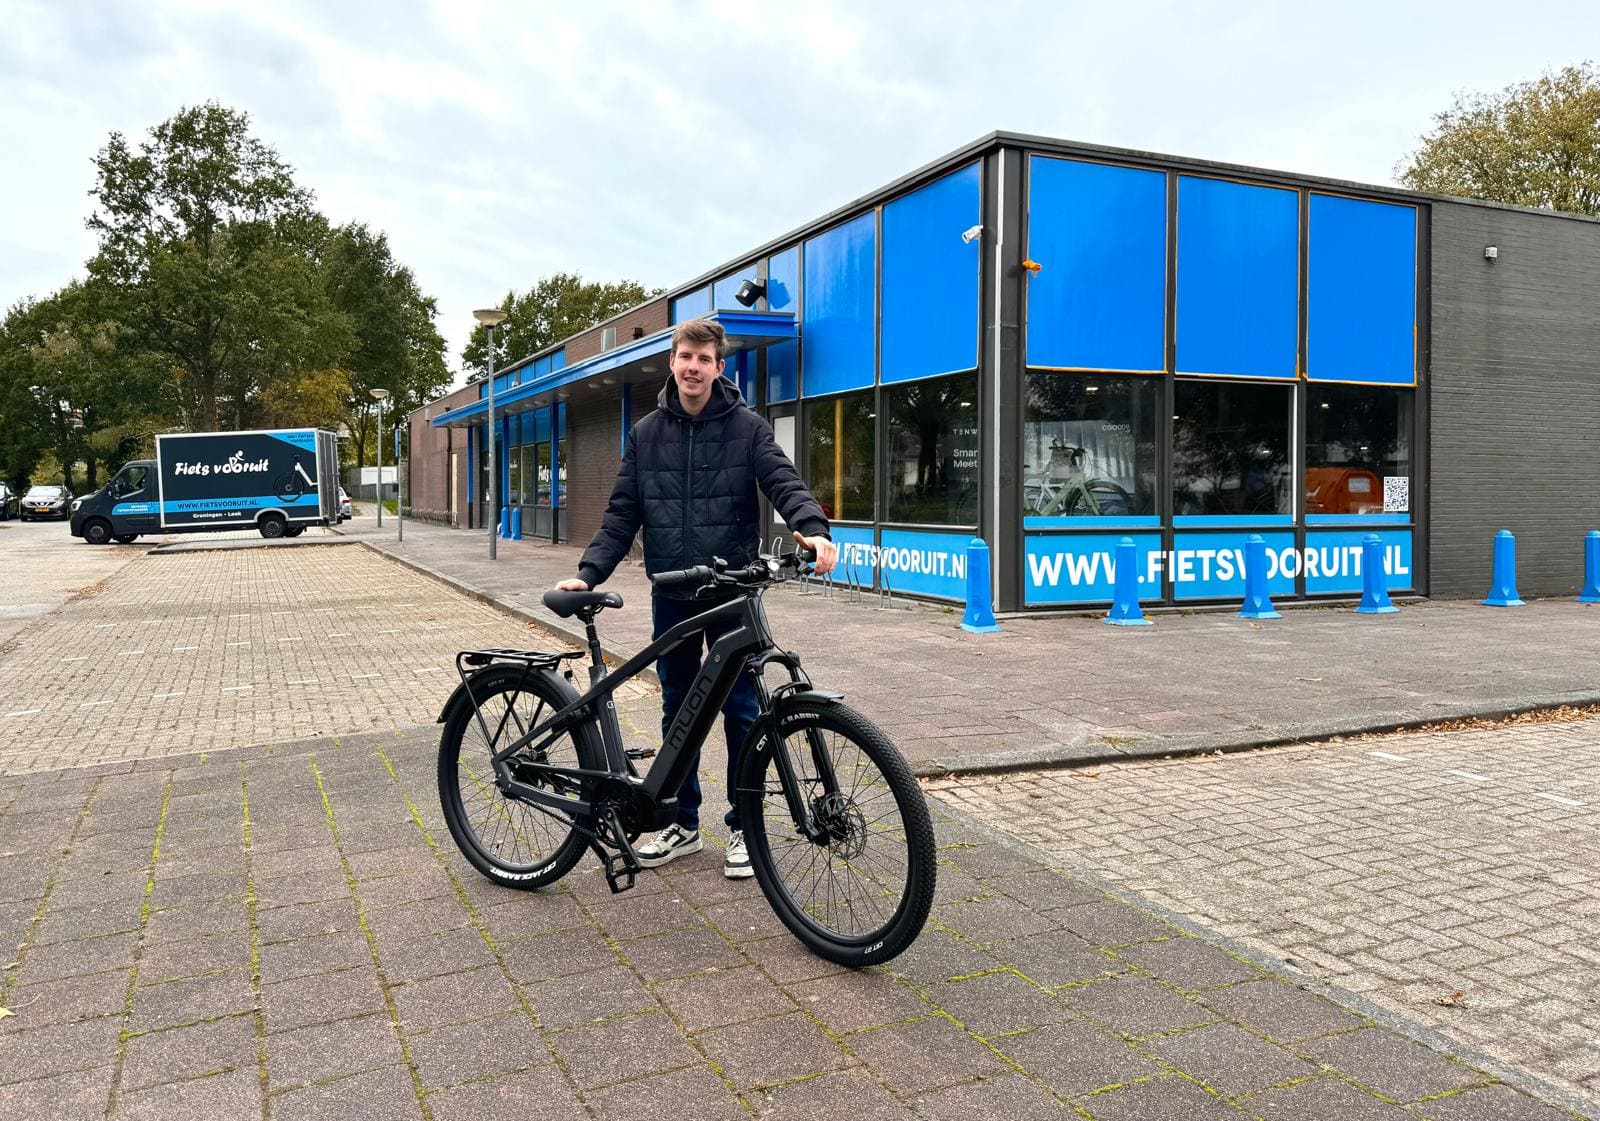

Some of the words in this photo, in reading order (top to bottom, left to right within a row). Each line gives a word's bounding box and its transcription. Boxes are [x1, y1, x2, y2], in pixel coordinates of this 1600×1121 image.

[174, 462, 210, 476] Fiets
[213, 458, 270, 474] vooruit
[177, 500, 259, 509] WWW.FIETSVOORUIT.NL
[756, 734, 768, 751] CST
[786, 712, 820, 723] RABBIT
